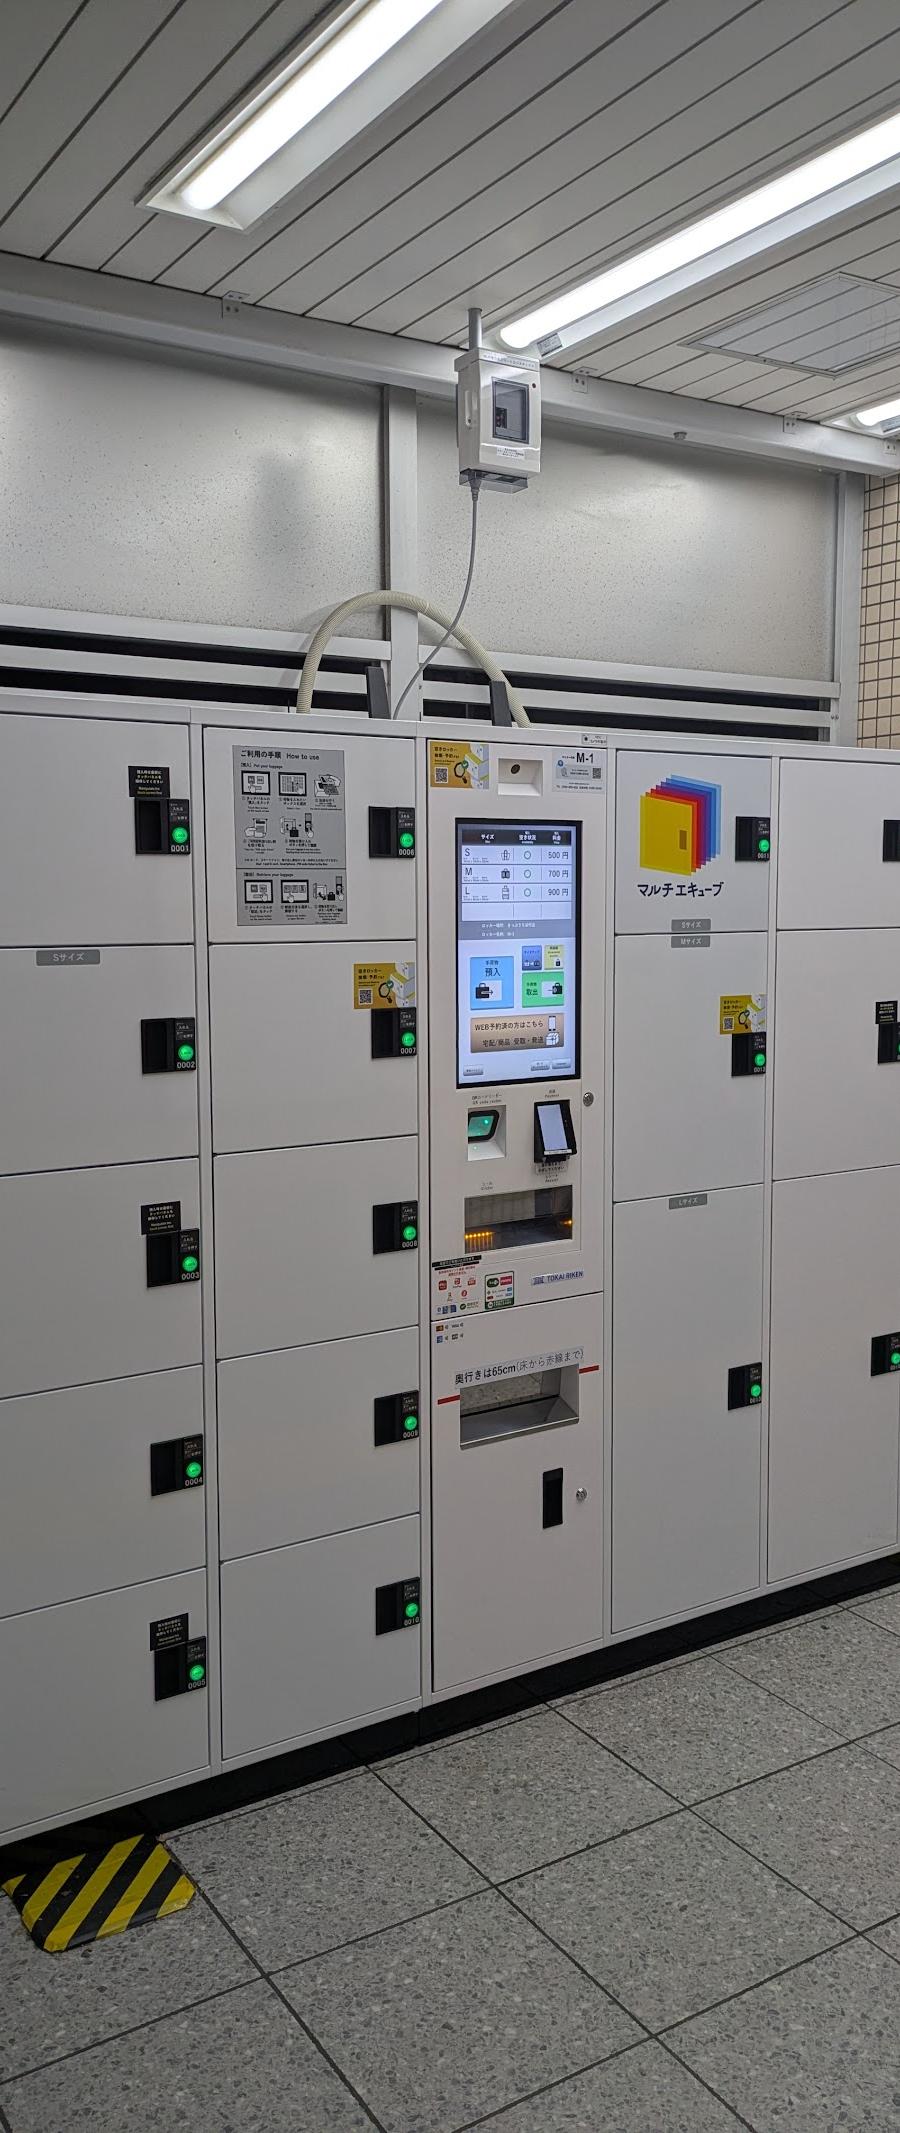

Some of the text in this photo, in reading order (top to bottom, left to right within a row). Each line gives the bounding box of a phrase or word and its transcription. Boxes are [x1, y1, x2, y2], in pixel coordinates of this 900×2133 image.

[240, 750, 282, 759] ご利用の手順
[576, 752, 594, 764] M-1
[464, 848, 470, 856] S
[465, 868, 472, 876] M
[637, 882, 724, 898] マルチエキューブ
[53, 953, 84, 961] Sサイズ
[485, 968, 501, 977] 預入
[474, 1020, 544, 1031] WEB予約済の方はこちら
[182, 1272, 200, 1280] 0003
[455, 1348, 584, 1384] 奥行きは65cm(床から赤線まで)
[185, 1477, 202, 1486] 0004
[188, 1679, 205, 1689] 0005
